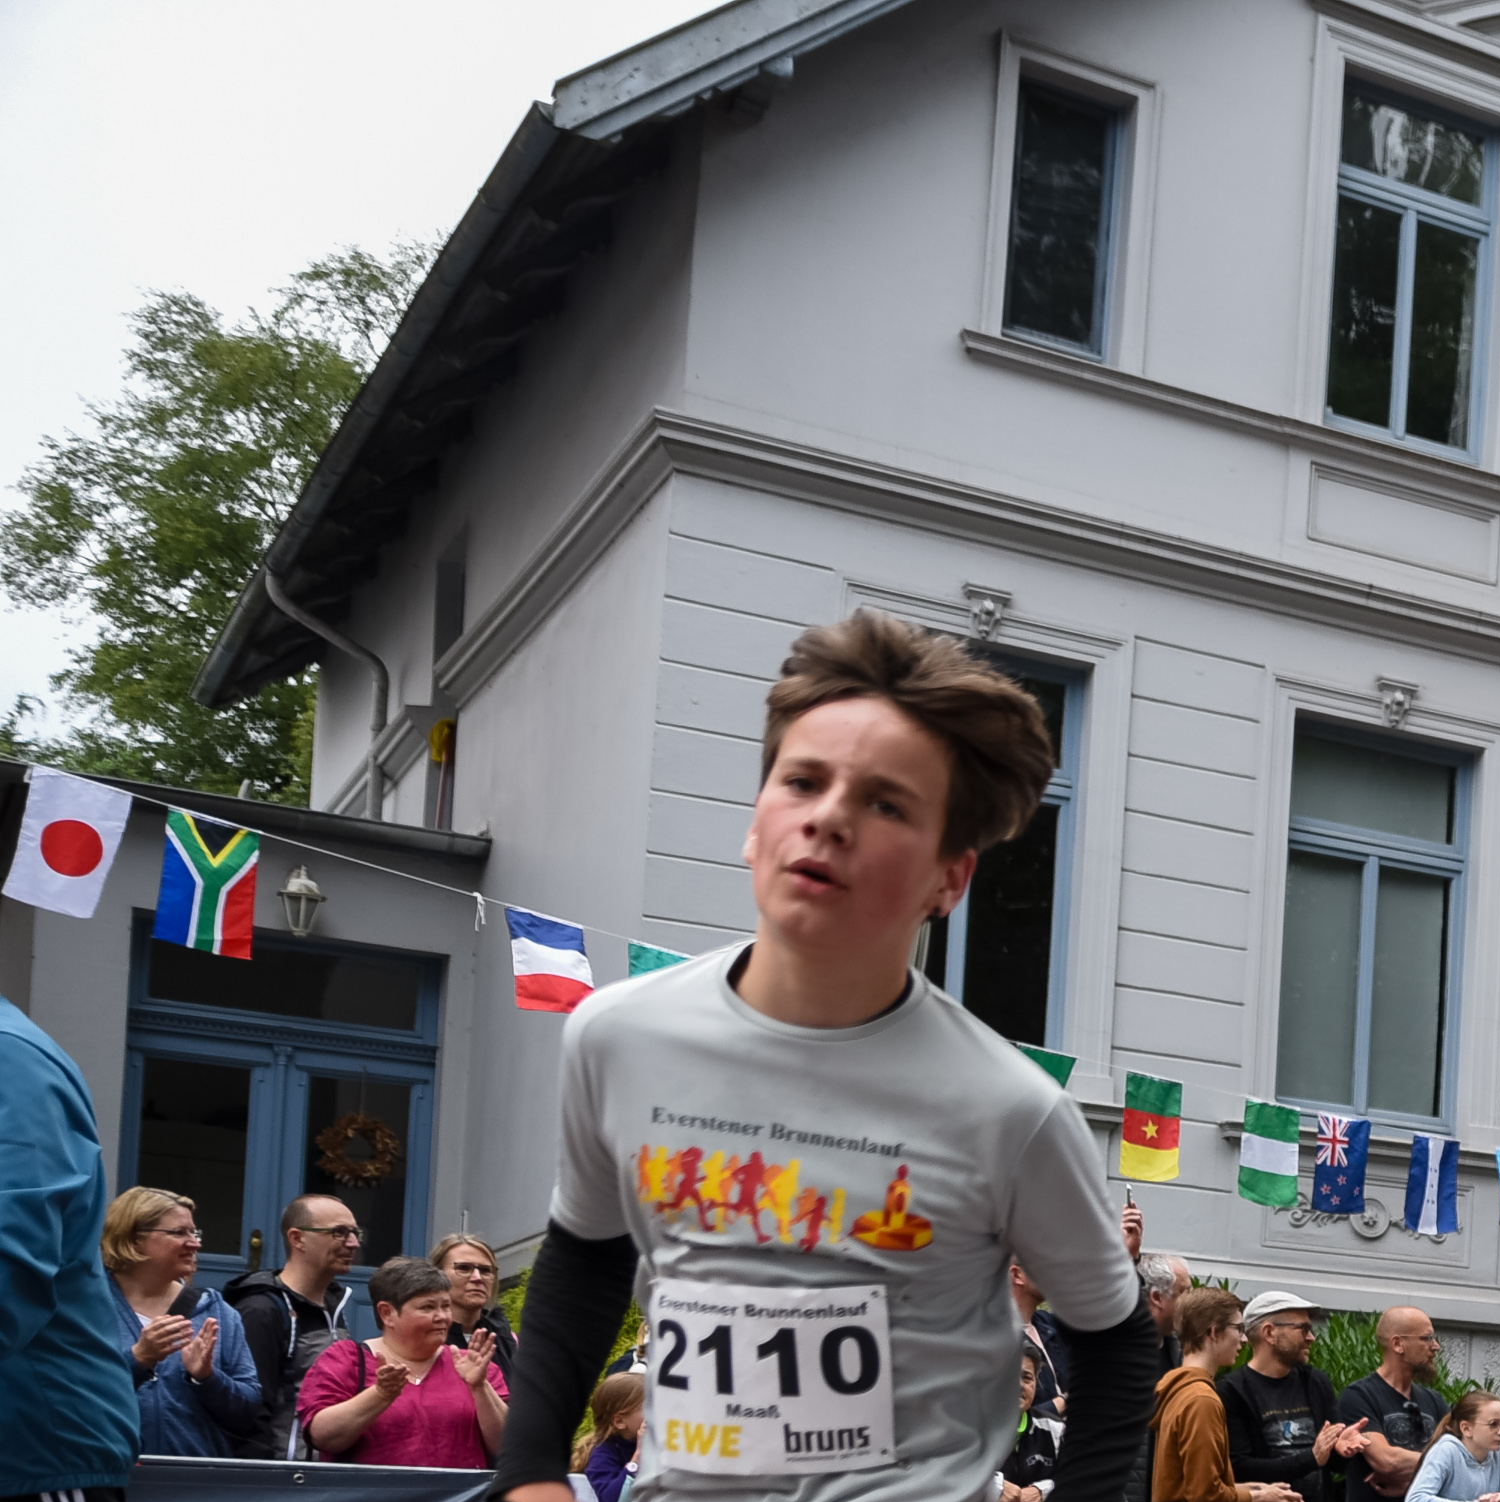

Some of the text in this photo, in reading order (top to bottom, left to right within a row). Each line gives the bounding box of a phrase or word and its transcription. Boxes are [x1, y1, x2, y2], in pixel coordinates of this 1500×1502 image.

[651, 1105, 905, 1158] Everstener Brunnenlauf
[659, 1295, 868, 1319] Everstener Brunnenlauf
[657, 1319, 880, 1397] 2110
[726, 1403, 781, 1419] Maaß
[666, 1418, 742, 1458] EWE
[783, 1423, 871, 1454] bruns
